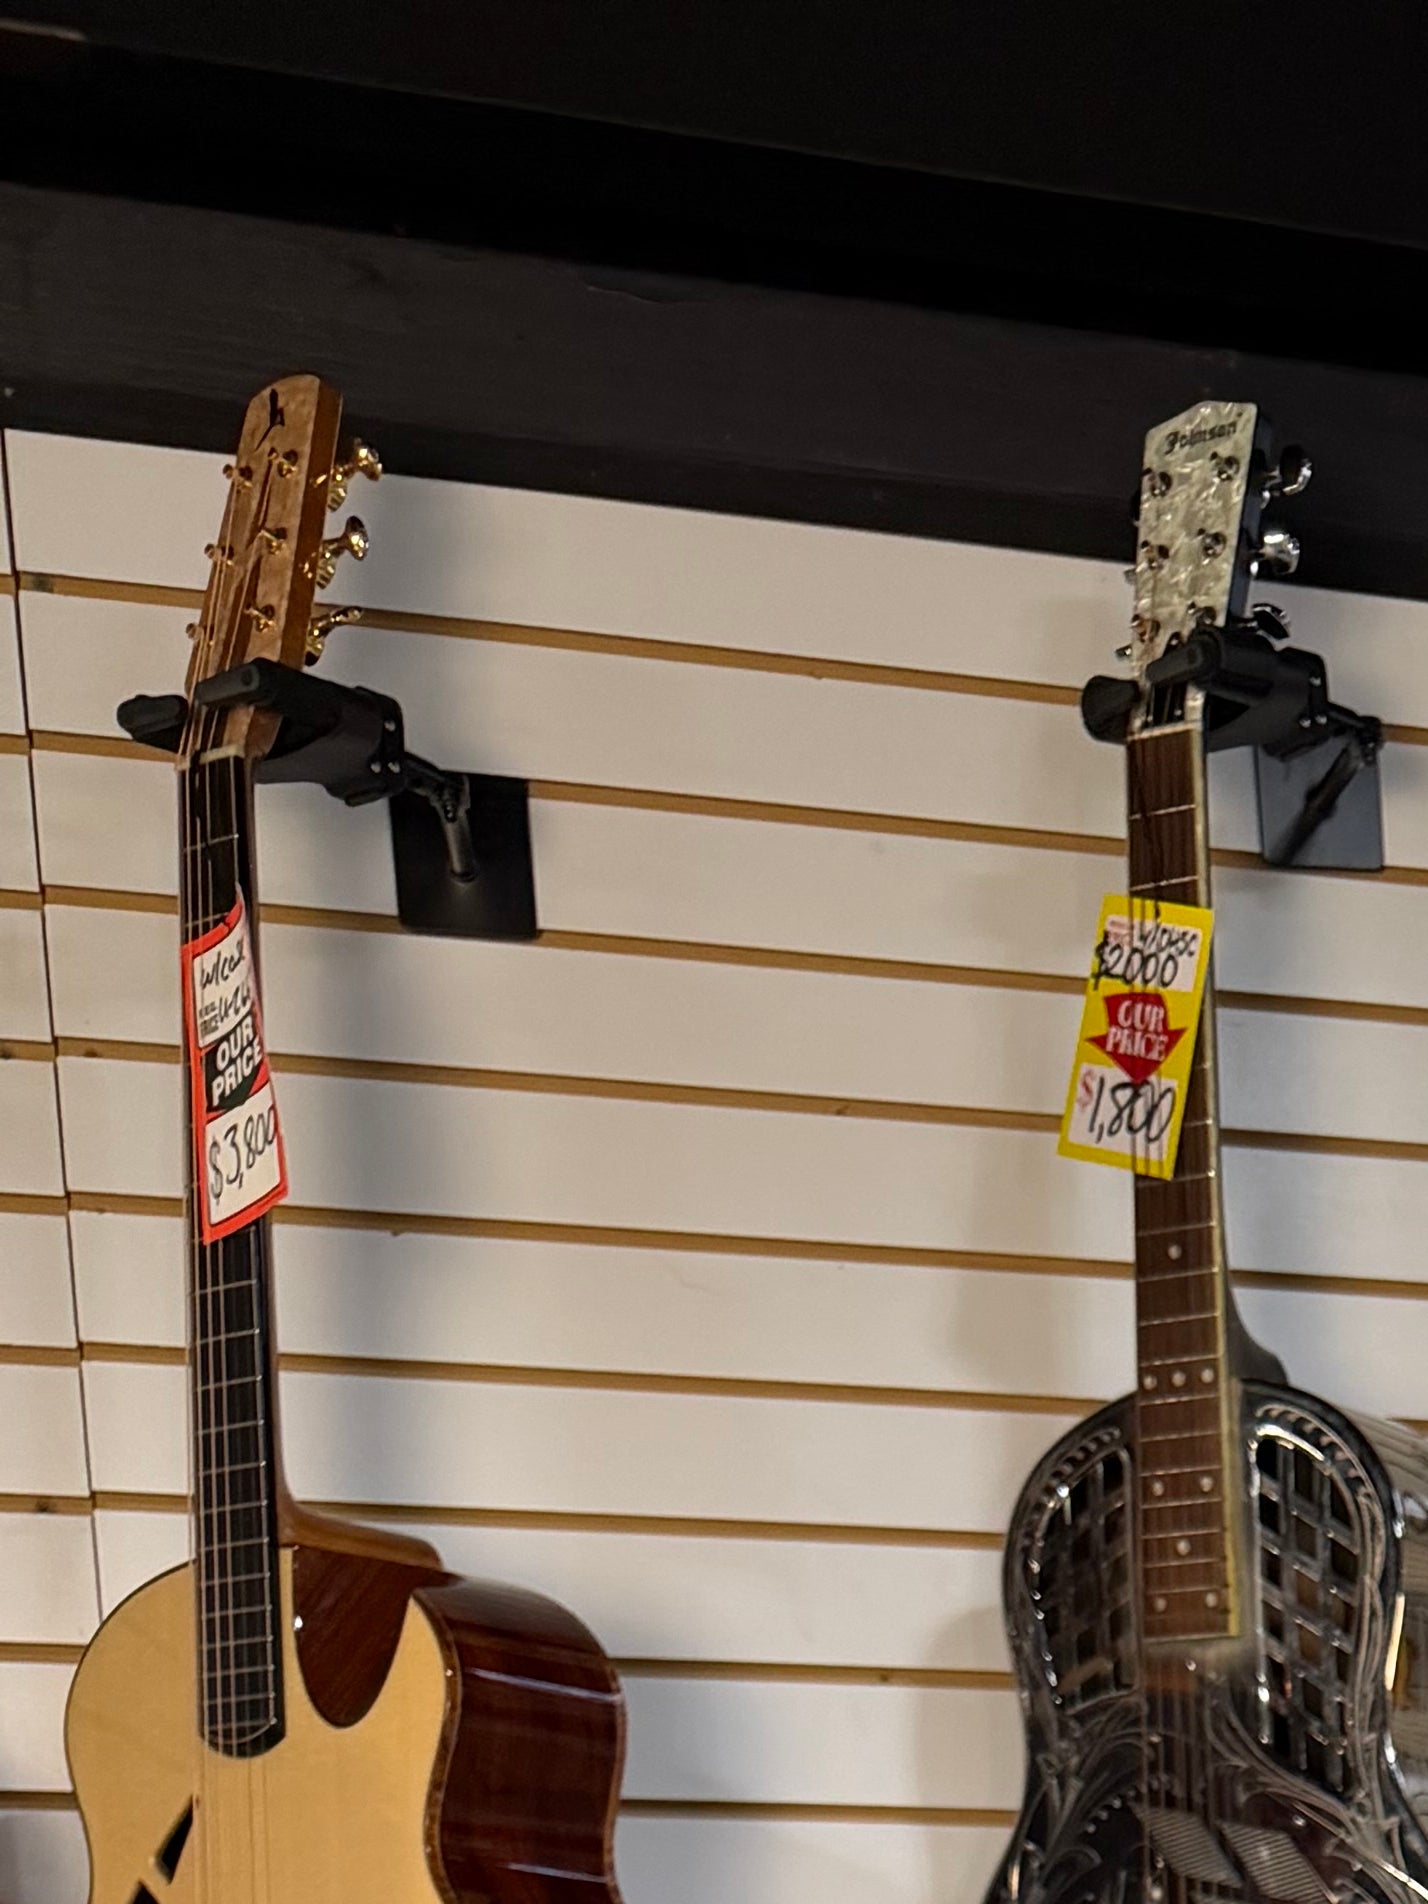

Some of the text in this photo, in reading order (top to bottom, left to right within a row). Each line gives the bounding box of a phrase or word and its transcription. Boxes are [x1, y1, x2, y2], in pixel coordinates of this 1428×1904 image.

[1165, 420, 1238, 455] Johnson
[1117, 1000, 1166, 1031] OUR
[216, 1015, 254, 1071] OUR
[1106, 1025, 1169, 1062] PRICE
[211, 1039, 263, 1107] PRICE
[208, 1106, 277, 1204] $3,800
